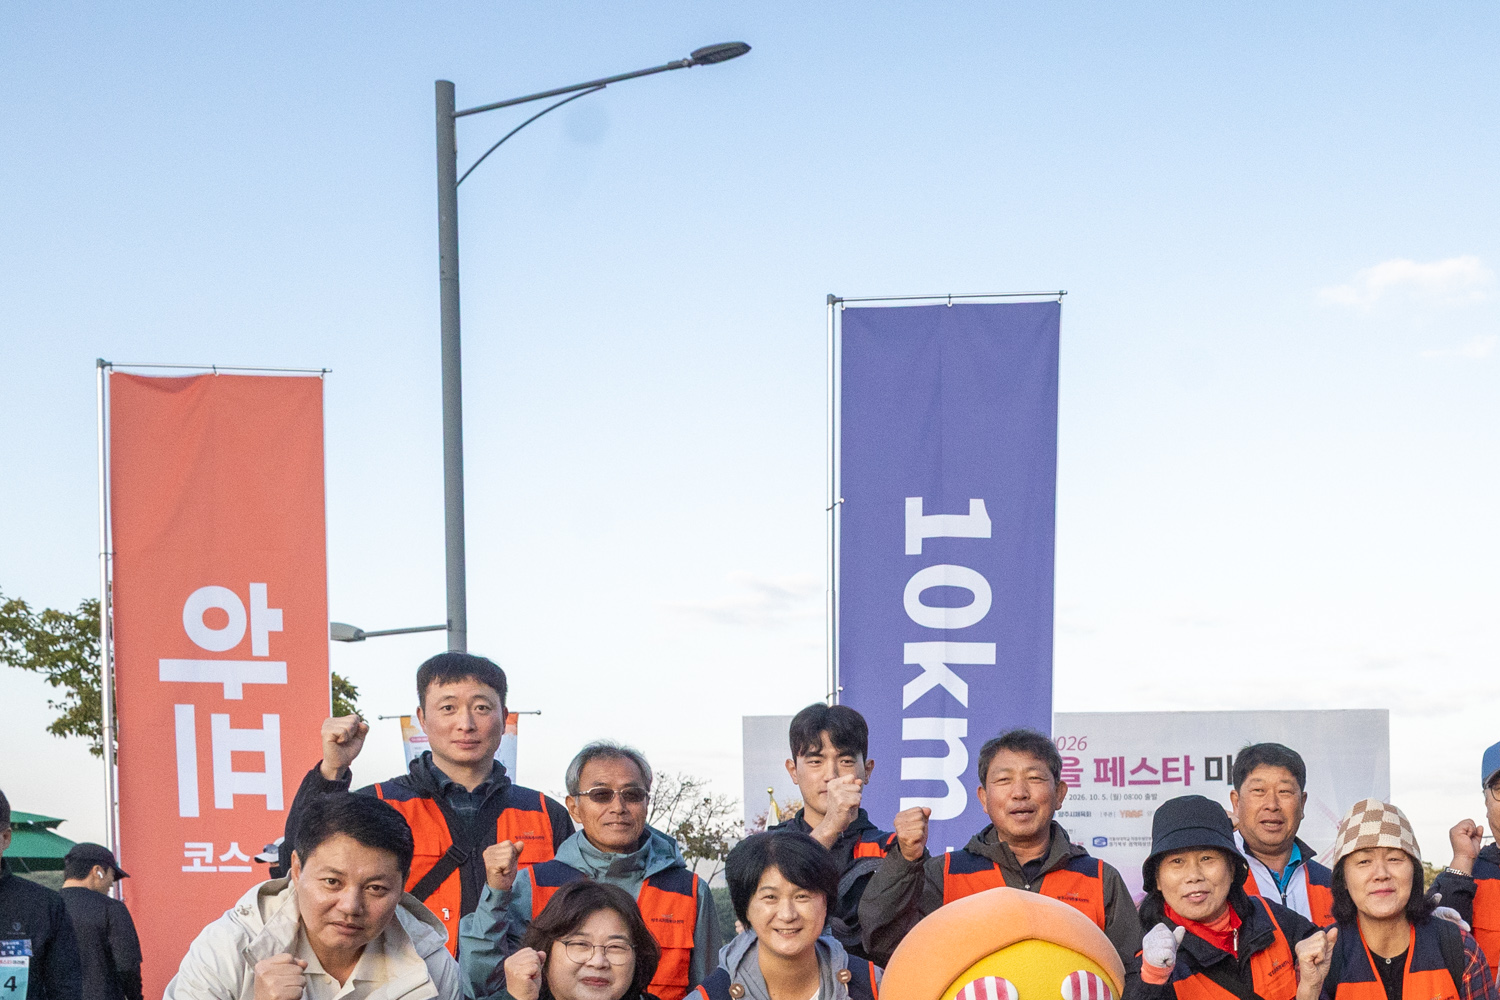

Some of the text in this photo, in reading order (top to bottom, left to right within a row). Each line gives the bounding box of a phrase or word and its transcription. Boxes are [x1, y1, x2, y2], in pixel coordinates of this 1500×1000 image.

[899, 496, 997, 821] 10km
[158, 582, 288, 819] 하프
[1054, 736, 1088, 751] 026
[1060, 755, 1233, 788] 을 페스타 마
[181, 841, 253, 873] 코스
[3, 975, 18, 992] 4
